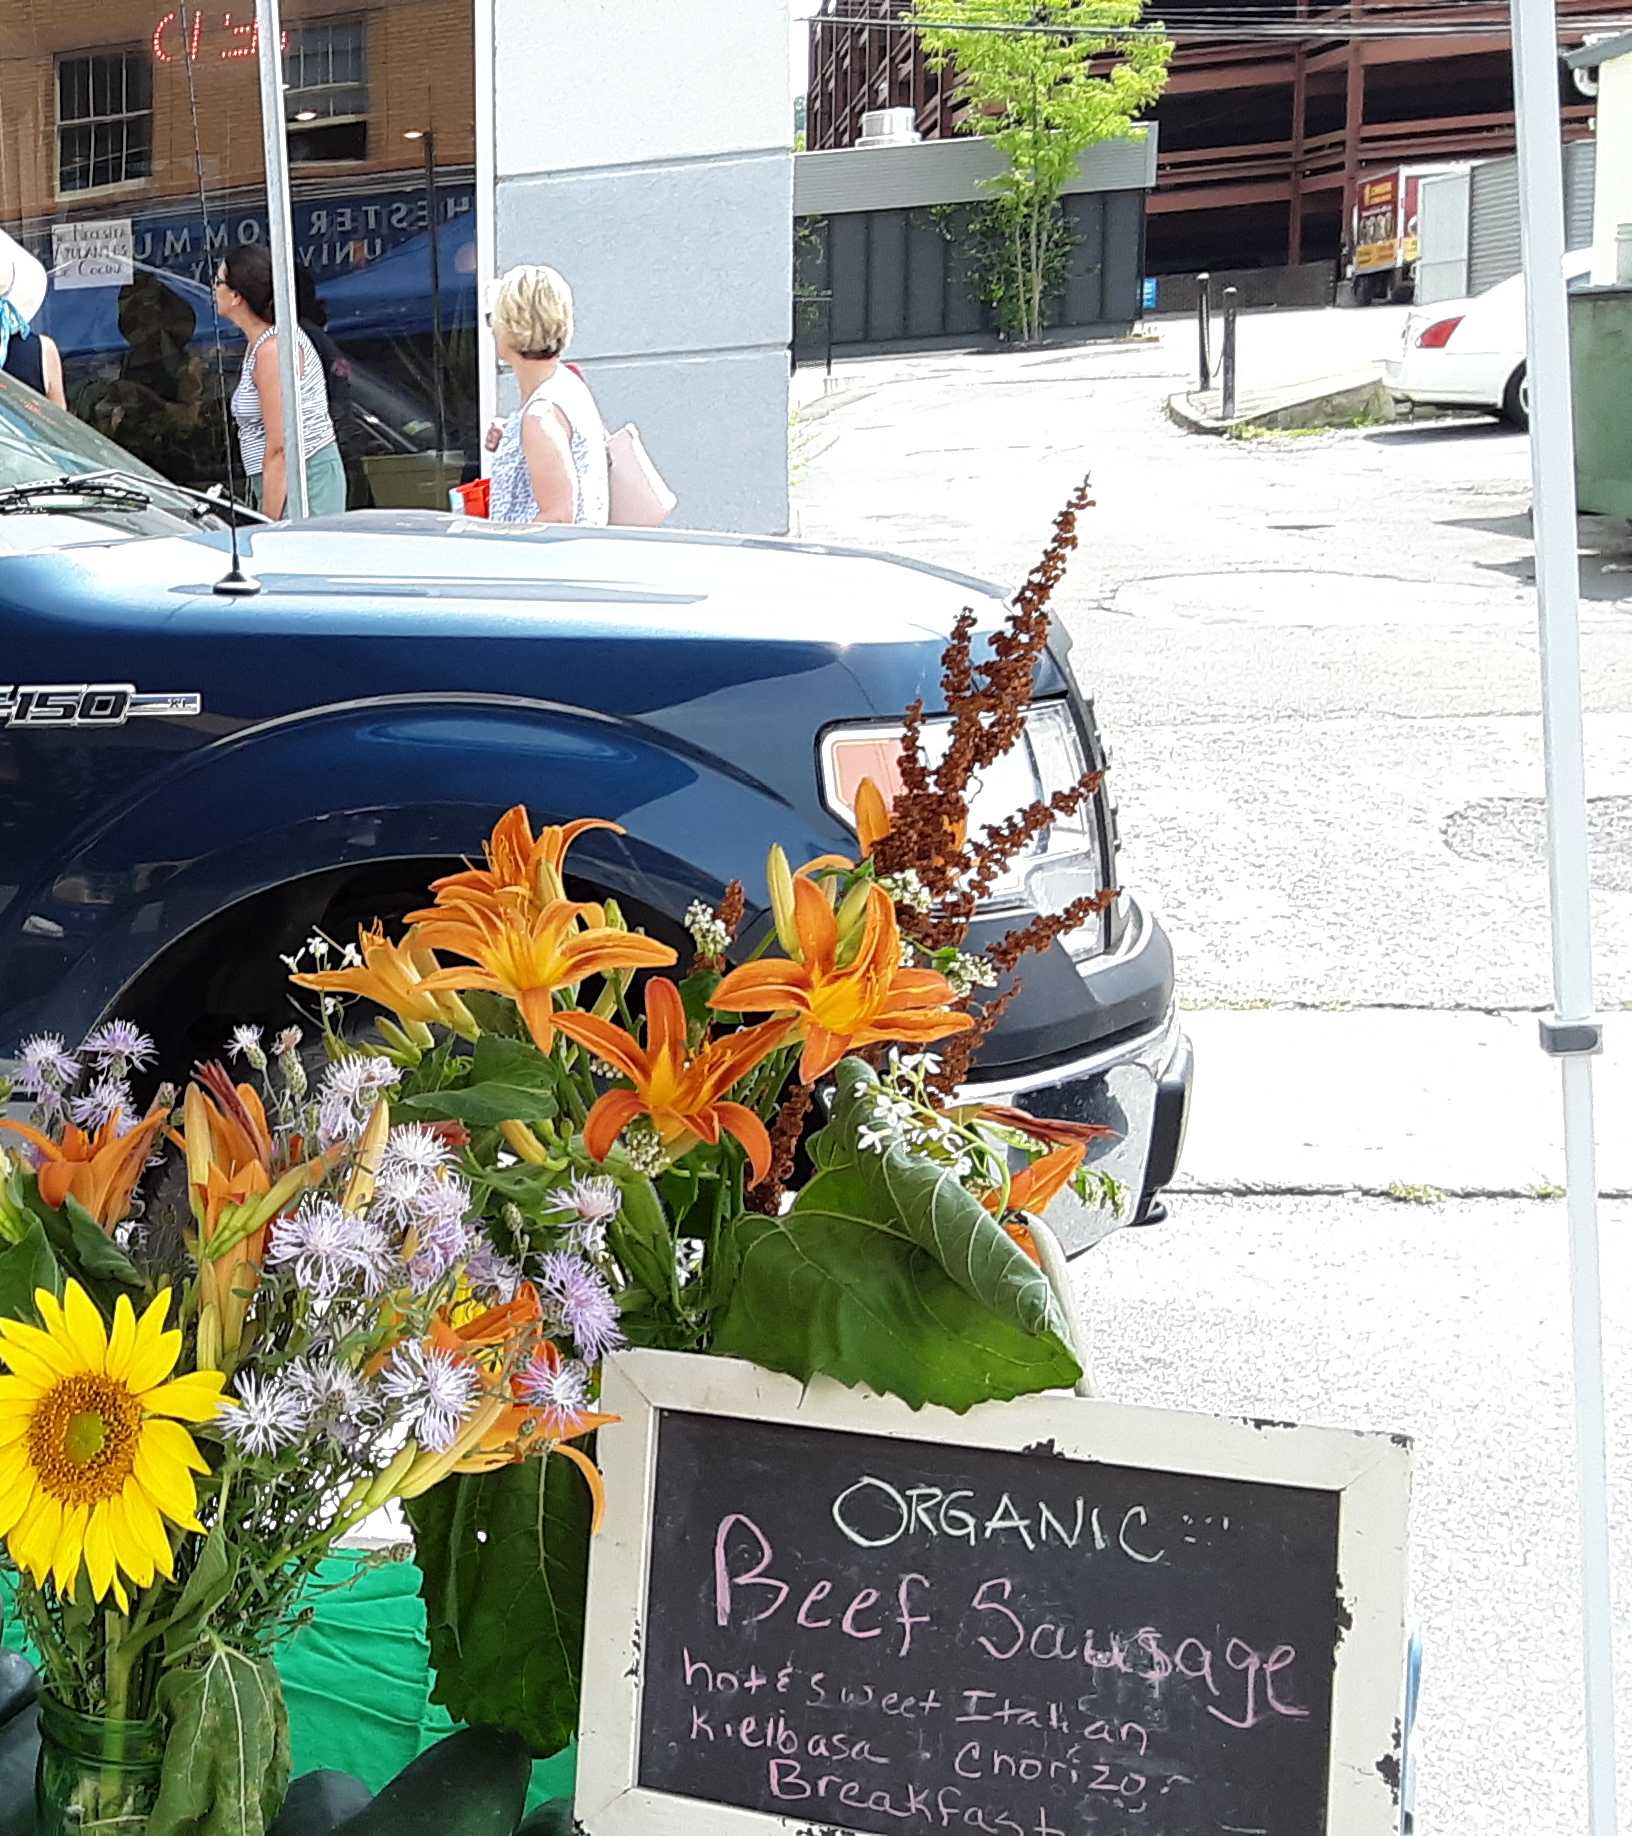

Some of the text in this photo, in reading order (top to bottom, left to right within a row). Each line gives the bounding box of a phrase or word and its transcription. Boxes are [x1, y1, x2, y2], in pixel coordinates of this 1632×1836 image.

[832, 1475, 1166, 1563] ORGANIC
[715, 1513, 1309, 1728] Beef Sausage
[683, 1646, 767, 1694] hot
[770, 1758, 1065, 1836] Breakfast
